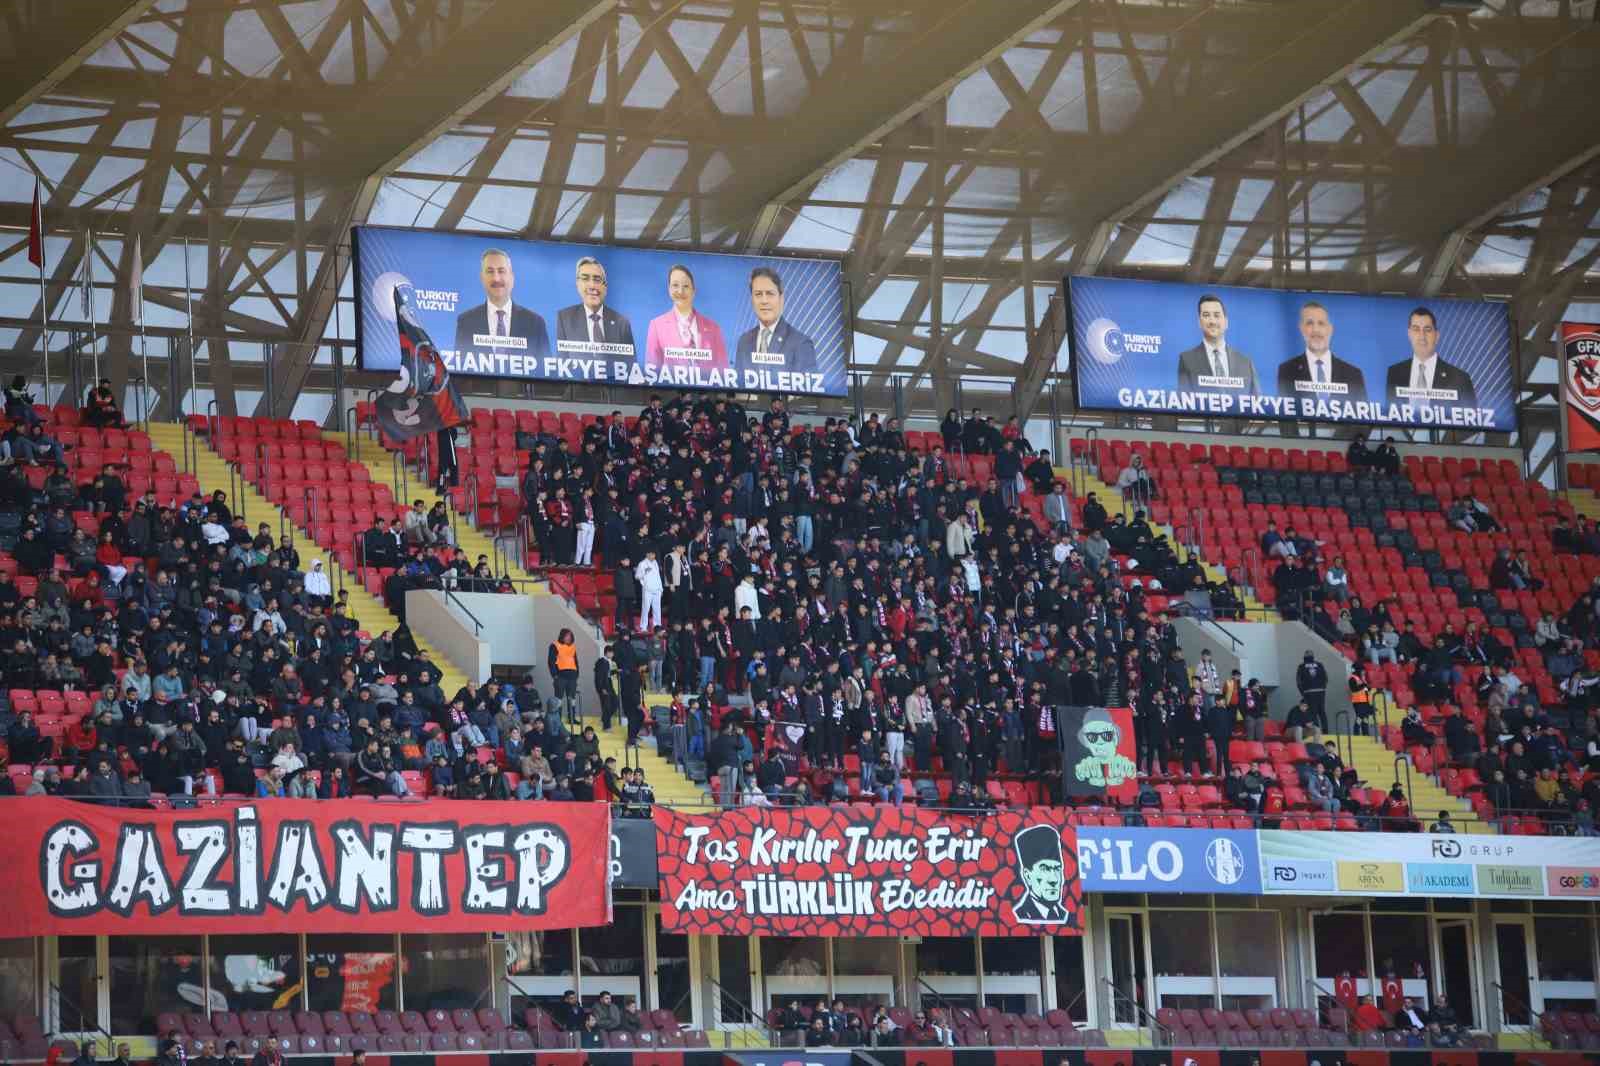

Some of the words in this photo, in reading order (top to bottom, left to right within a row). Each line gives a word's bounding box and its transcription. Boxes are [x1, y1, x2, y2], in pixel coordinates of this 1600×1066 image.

[614, 361, 738, 388] BAŞARILAR
[1302, 398, 1415, 422] BAŞARILAR
[684, 827, 739, 869] Taş
[751, 827, 839, 866] Kırılır
[846, 827, 919, 871] Tunç
[924, 827, 988, 864] Erir
[1470, 846, 1513, 857] GRUP
[676, 879, 738, 911] Ama
[741, 873, 874, 914] TÜRKLÜK
[880, 878, 995, 912] Ebedidir
